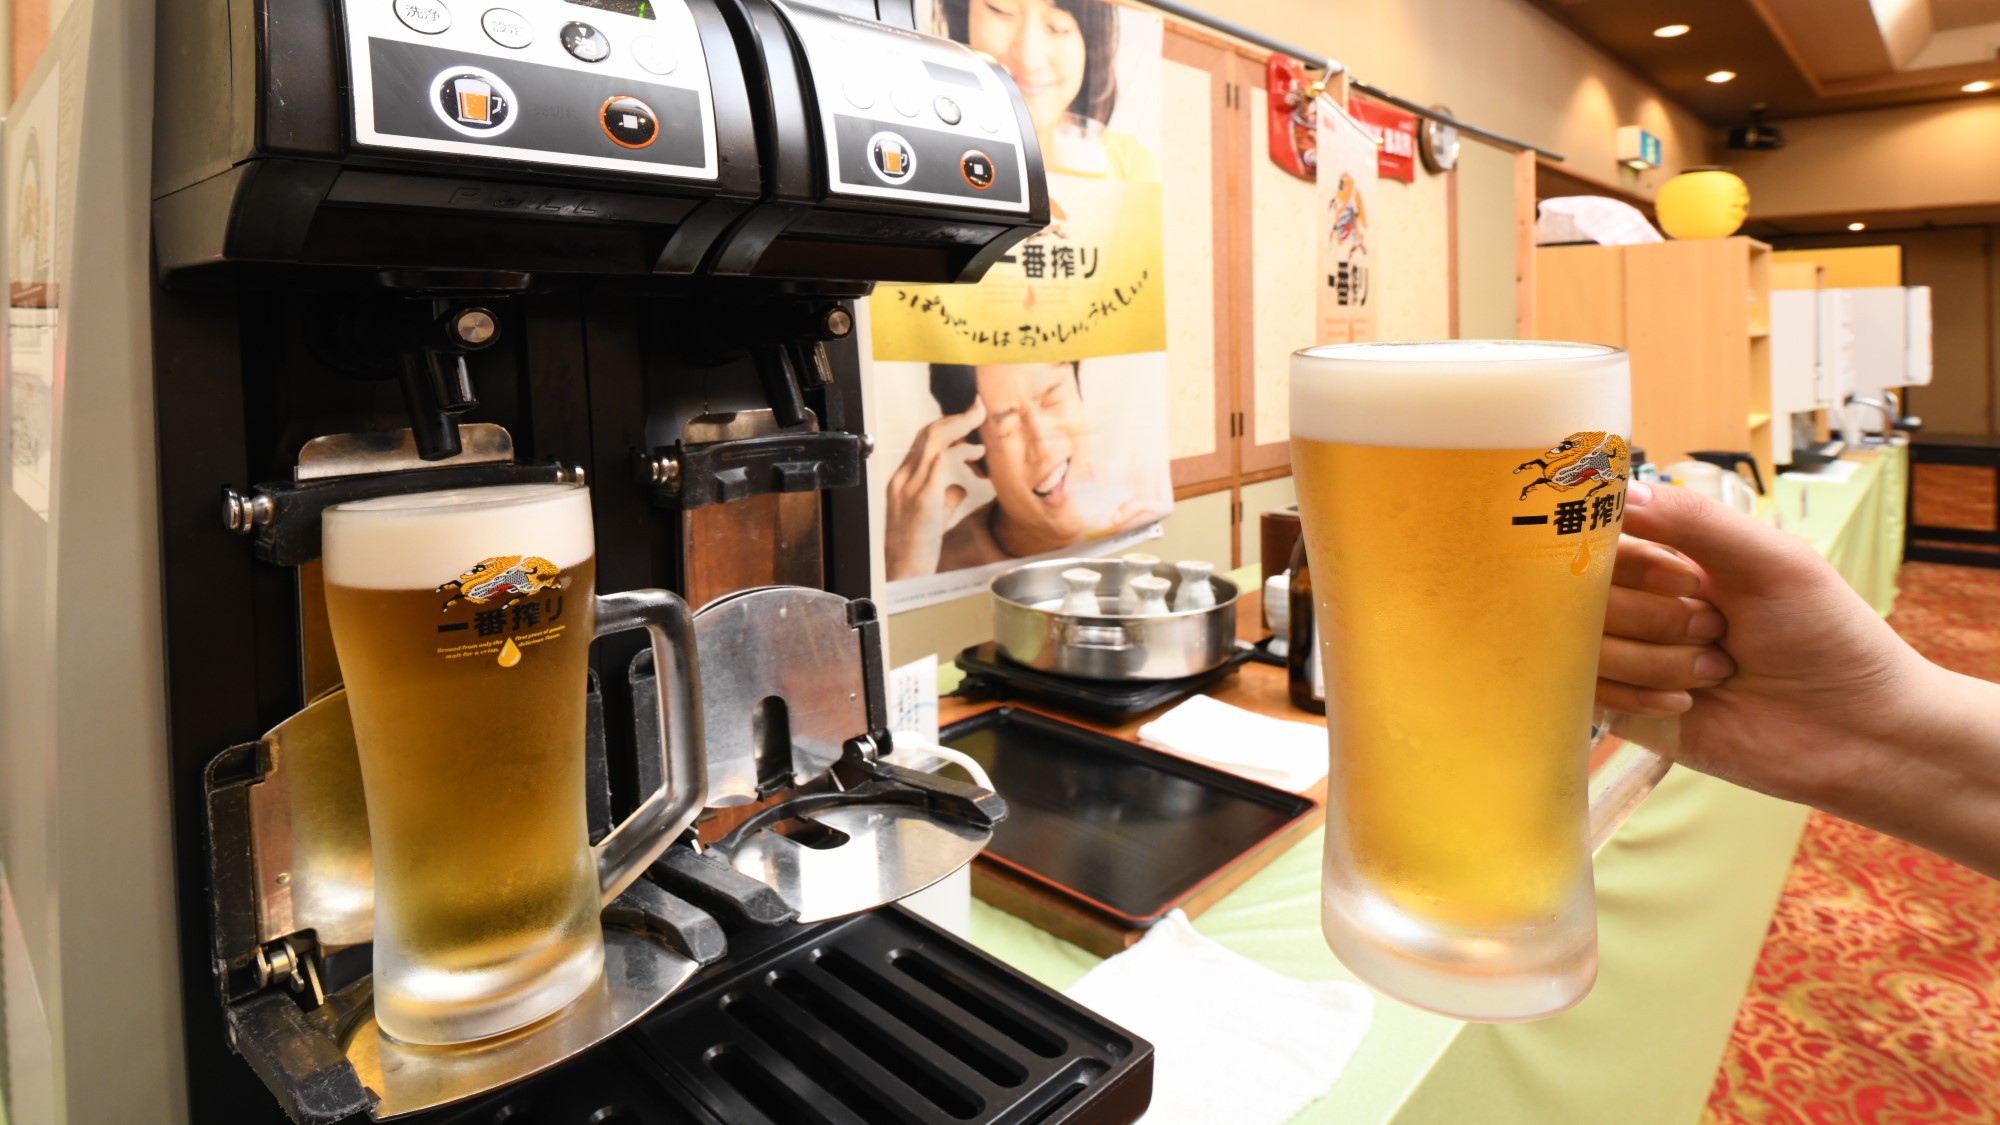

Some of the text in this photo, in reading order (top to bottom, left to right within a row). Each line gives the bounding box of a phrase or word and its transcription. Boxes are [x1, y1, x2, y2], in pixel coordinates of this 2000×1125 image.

[405, 4, 441, 22] 洗浄
[997, 245, 1098, 279] 一番搾り
[1511, 488, 1627, 535] 一番搾り
[437, 596, 564, 637] 一番搾り
